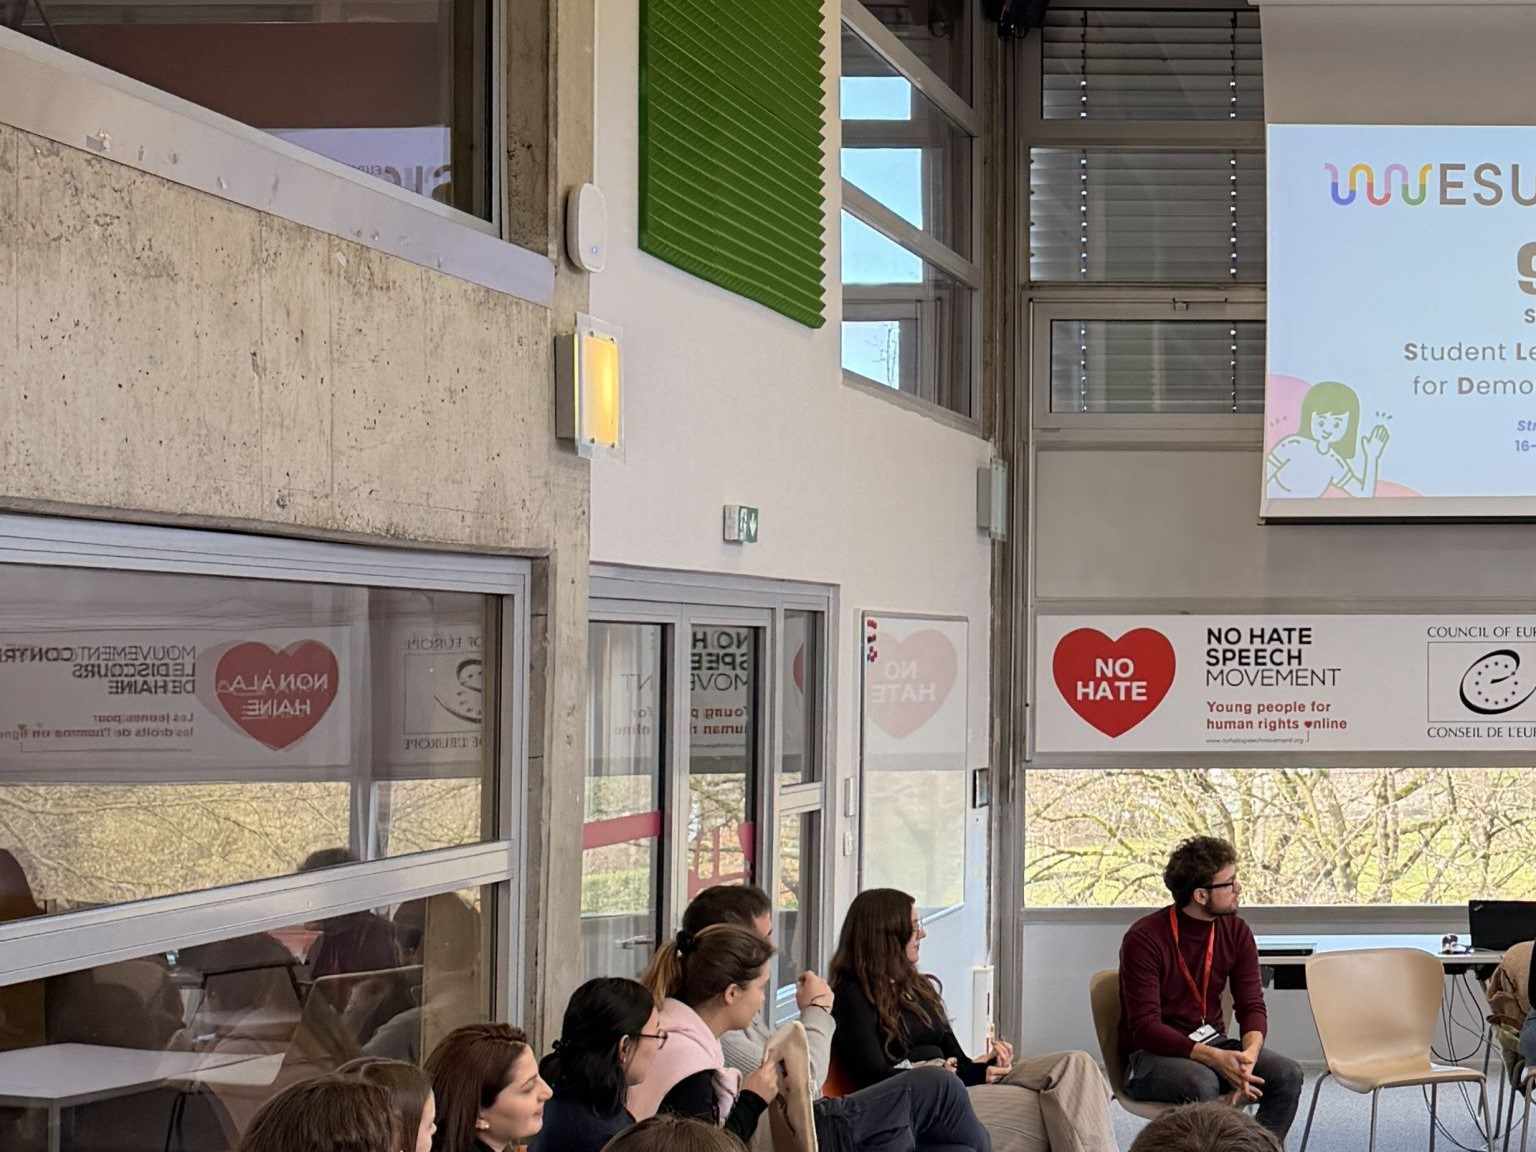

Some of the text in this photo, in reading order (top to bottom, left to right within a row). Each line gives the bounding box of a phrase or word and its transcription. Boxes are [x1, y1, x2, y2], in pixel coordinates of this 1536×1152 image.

[1403, 342, 1506, 362] Student
[1412, 375, 1448, 395] for
[1207, 627, 1312, 645] NO HATE
[1427, 626, 1487, 638] COUNCIL
[1493, 626, 1511, 638] OF
[1206, 648, 1302, 667] SPEECH
[1095, 658, 1134, 679] NO
[1206, 668, 1342, 687] MOVEMENT
[1076, 681, 1148, 701] HATE
[1207, 700, 1331, 716] Young people for
[1207, 718, 1254, 729] human
[1258, 718, 1299, 731] rights
[1427, 727, 1483, 738] CONSEIL
[1487, 727, 1503, 738] DE
